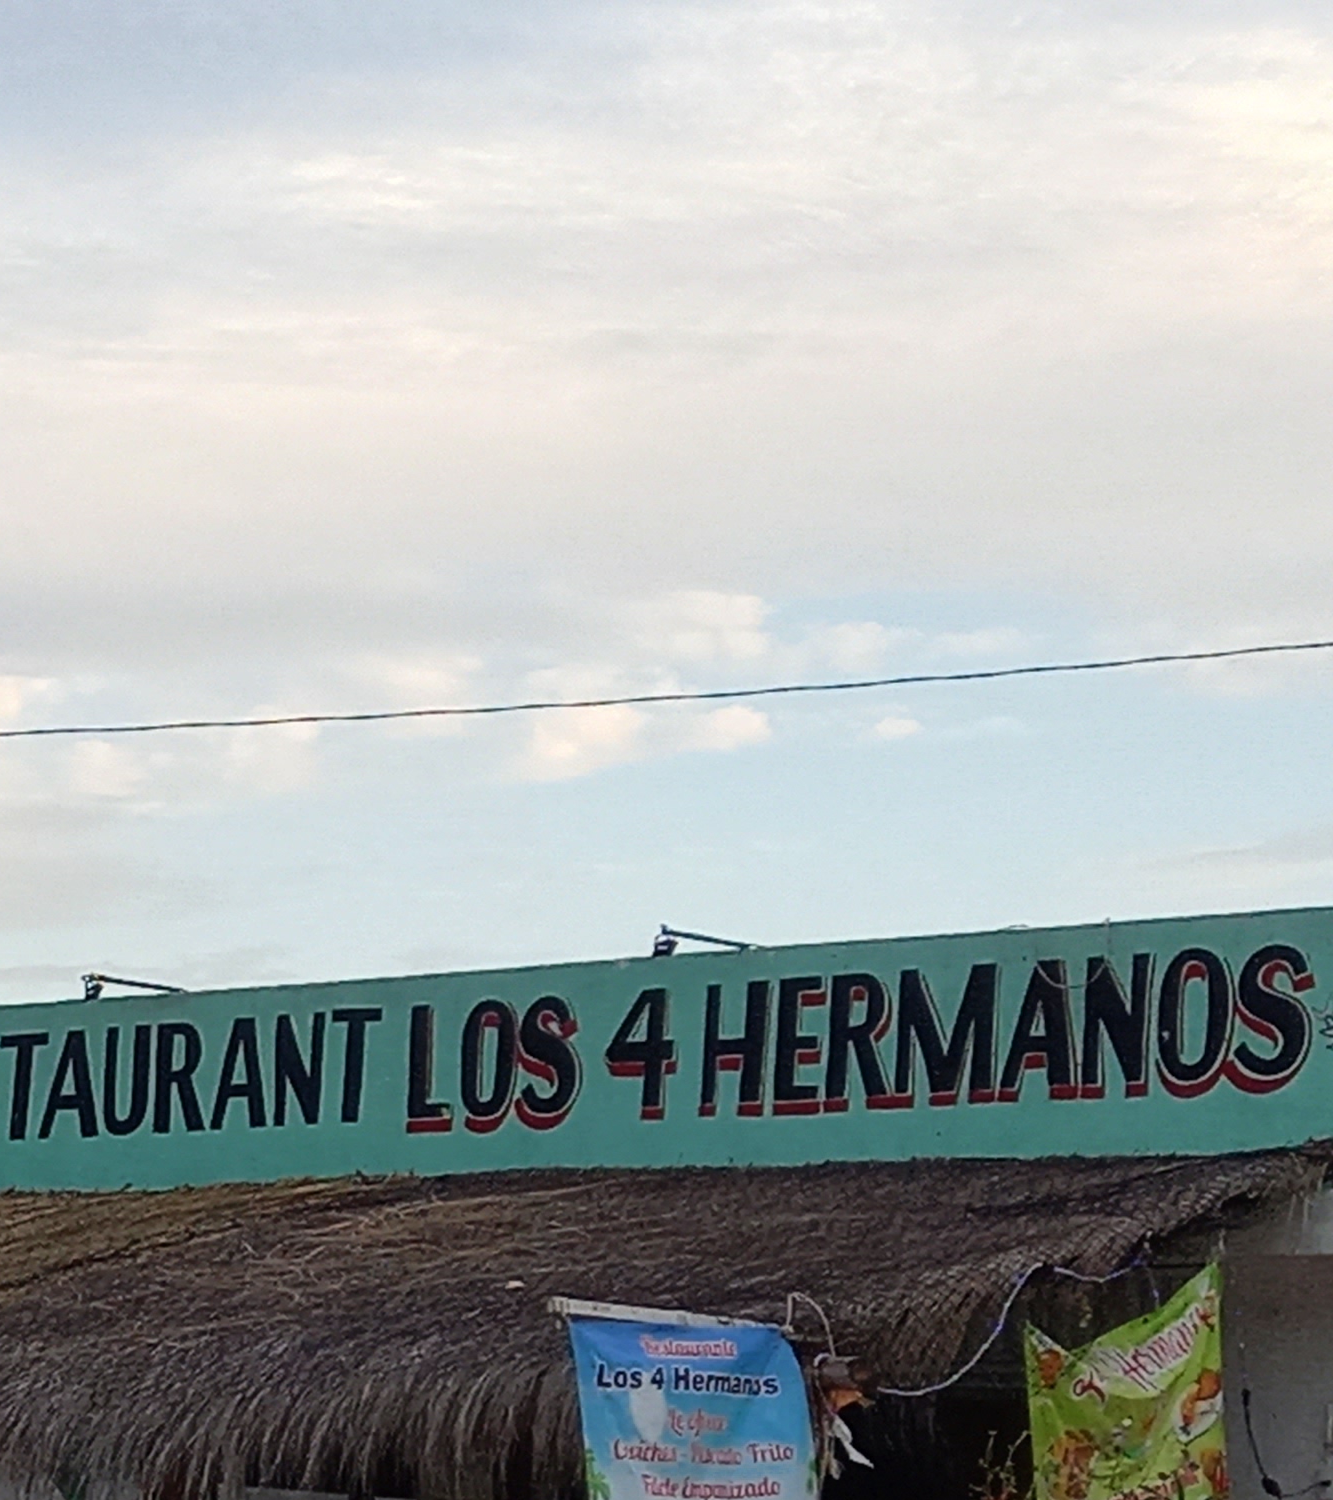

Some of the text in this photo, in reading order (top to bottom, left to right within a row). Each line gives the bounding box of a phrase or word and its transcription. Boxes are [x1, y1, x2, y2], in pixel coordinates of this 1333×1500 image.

[405, 993, 584, 1135] LOS
[603, 984, 678, 1121] 4
[701, 942, 1319, 1118] HERMANOS
[595, 1361, 780, 1397] Los 4 Hermanos
